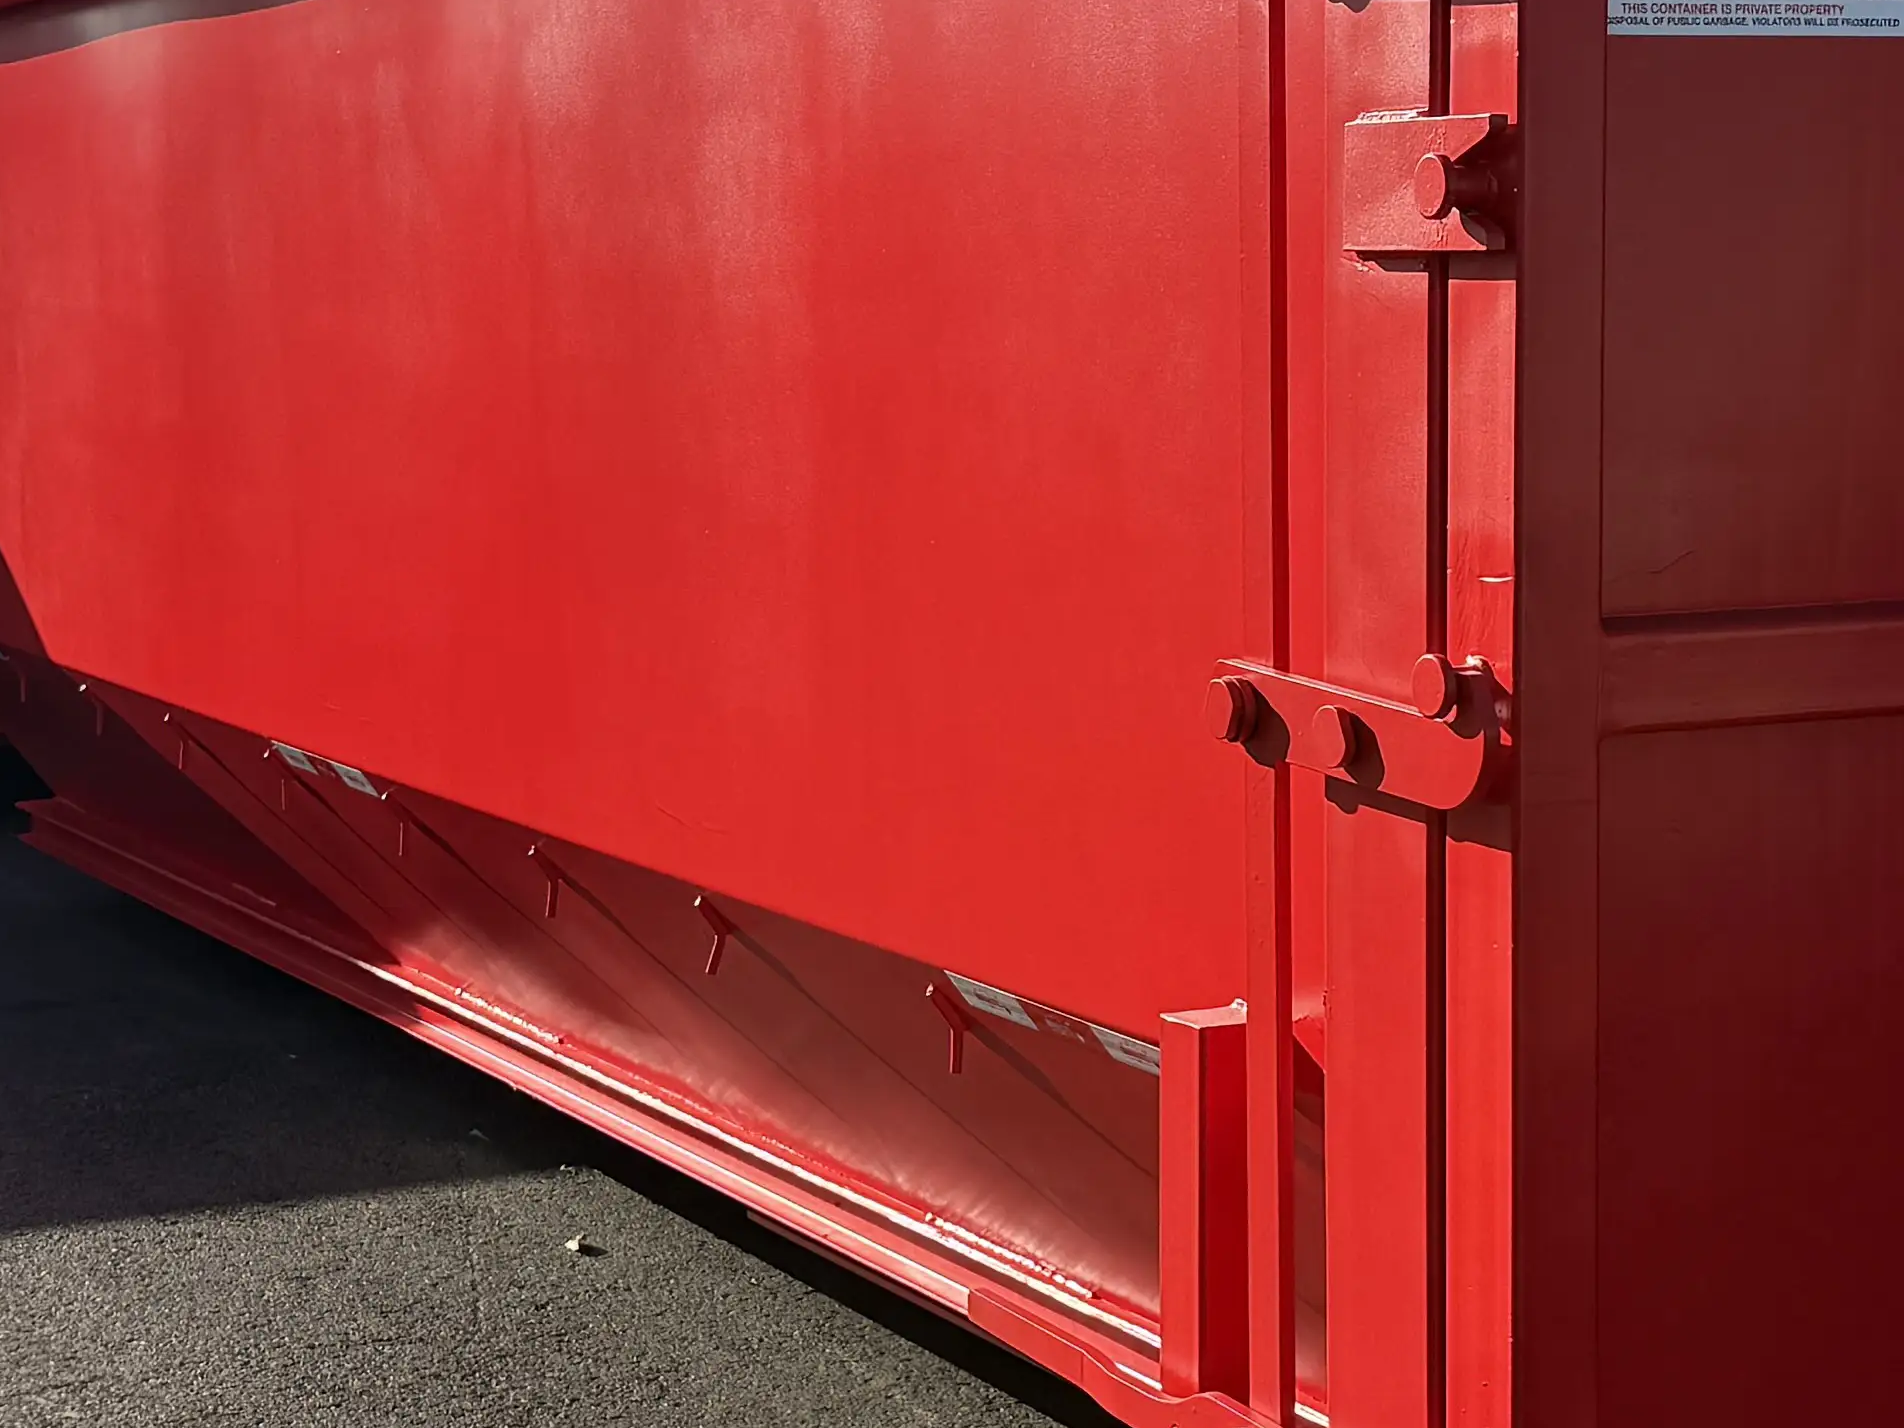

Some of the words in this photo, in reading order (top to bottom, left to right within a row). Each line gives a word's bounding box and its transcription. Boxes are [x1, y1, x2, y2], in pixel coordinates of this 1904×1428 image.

[1621, 2, 1647, 14] THIS
[1650, 2, 1718, 15] CONTAINER
[1721, 3, 1732, 15] IS
[1735, 3, 1782, 15] PRIVATE
[1784, 3, 1844, 16] PROPERTY
[1652, 16, 1663, 26] OF
[1667, 16, 1700, 26] PUBLIC
[1751, 16, 1801, 27] VIOLATORS
[1803, 17, 1825, 27] WILL
[1841, 18, 1900, 27] PROSECUTED
